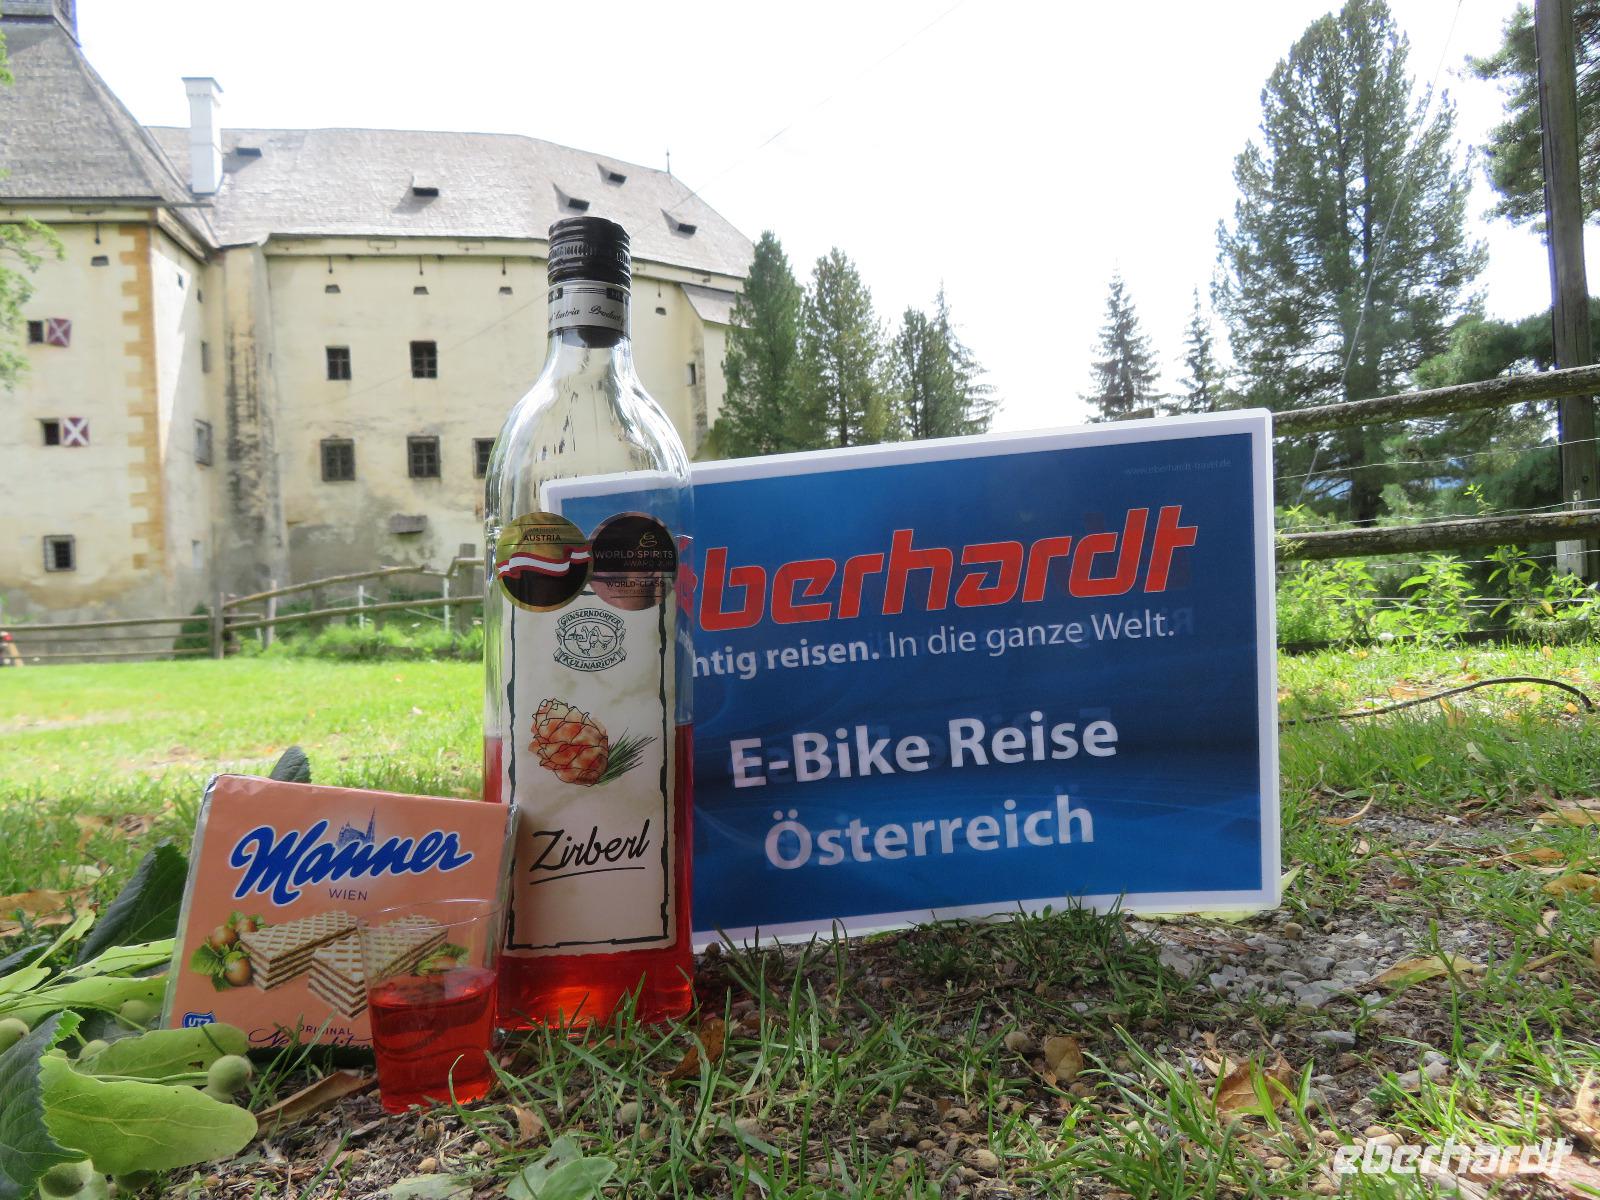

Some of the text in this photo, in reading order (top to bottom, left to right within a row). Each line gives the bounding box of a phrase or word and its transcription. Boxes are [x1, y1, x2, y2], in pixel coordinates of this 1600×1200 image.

[523, 534, 562, 542] AUSTRIA
[595, 550, 673, 559] WORLD SPIRITS
[692, 609, 1175, 681] htig reisen. In die ganze Welt.
[730, 711, 1119, 788] E-Bike Reise
[230, 818, 474, 906] Manner
[529, 819, 650, 872] Zirberl
[765, 795, 1093, 870] Österreich
[328, 888, 367, 901] WIEN
